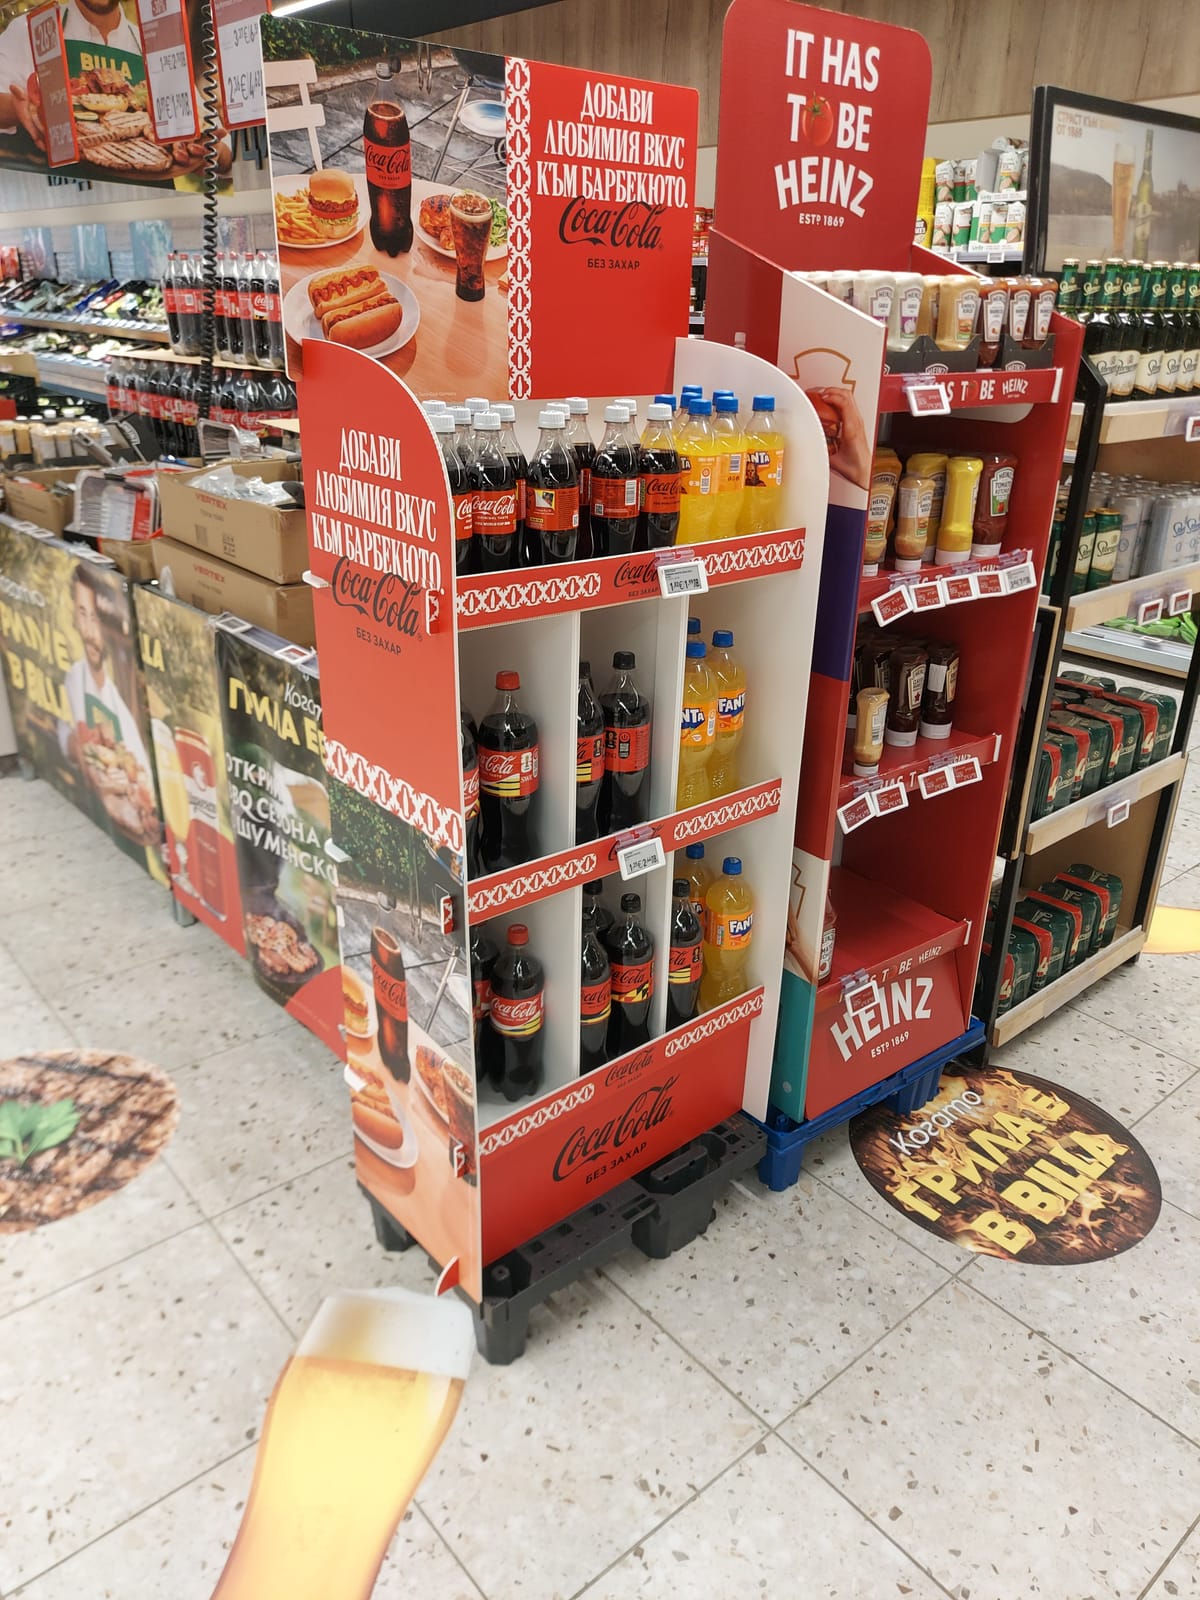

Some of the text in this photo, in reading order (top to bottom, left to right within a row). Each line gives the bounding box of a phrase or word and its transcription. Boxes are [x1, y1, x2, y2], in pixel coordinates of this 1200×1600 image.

[785, 28, 880, 92] IT HAS
[580, 81, 654, 125] ДОБАВИ
[837, 102, 873, 152] BE
[366, 145, 409, 174] Coca-Cola
[544, 120, 685, 170] ЛЮБИМИЯ ВКУС
[536, 160, 688, 208] КЪМ БАРБЕКЮТО.
[774, 156, 874, 218] HEINZ
[559, 195, 663, 249] Coca-Cola
[823, 214, 845, 228] 1869
[587, 258, 640, 270] БЕЗ ЗАХАР
[980, 379, 996, 401] BE
[1002, 378, 1029, 396] HEINZ
[339, 427, 402, 481] ДОБАВИ
[315, 469, 392, 529] ЛЮБИМИЯ
[394, 490, 437, 542] ВКУС
[472, 494, 515, 516] Coca-Cola
[311, 512, 445, 595] КЪМ БАРБЕКЮТО.
[332, 555, 421, 638] Coca-Cola
[356, 627, 402, 656] БЕЗ ЗАХАР
[898, 958, 913, 975] BE
[919, 946, 942, 964] HEINZ
[491, 997, 538, 1018] Coca-Cola
[830, 977, 933, 1062] HEINZ
[891, 1031, 909, 1047] 1869
[605, 1049, 653, 1087] Coca-Cola
[552, 1074, 680, 1182] Coca-Cola
[585, 1141, 647, 1184] БЕЗ ЗАХАР
[893, 1087, 1071, 1222] ГРИЛА Е
[970, 1130, 1129, 1255] В BILLA
